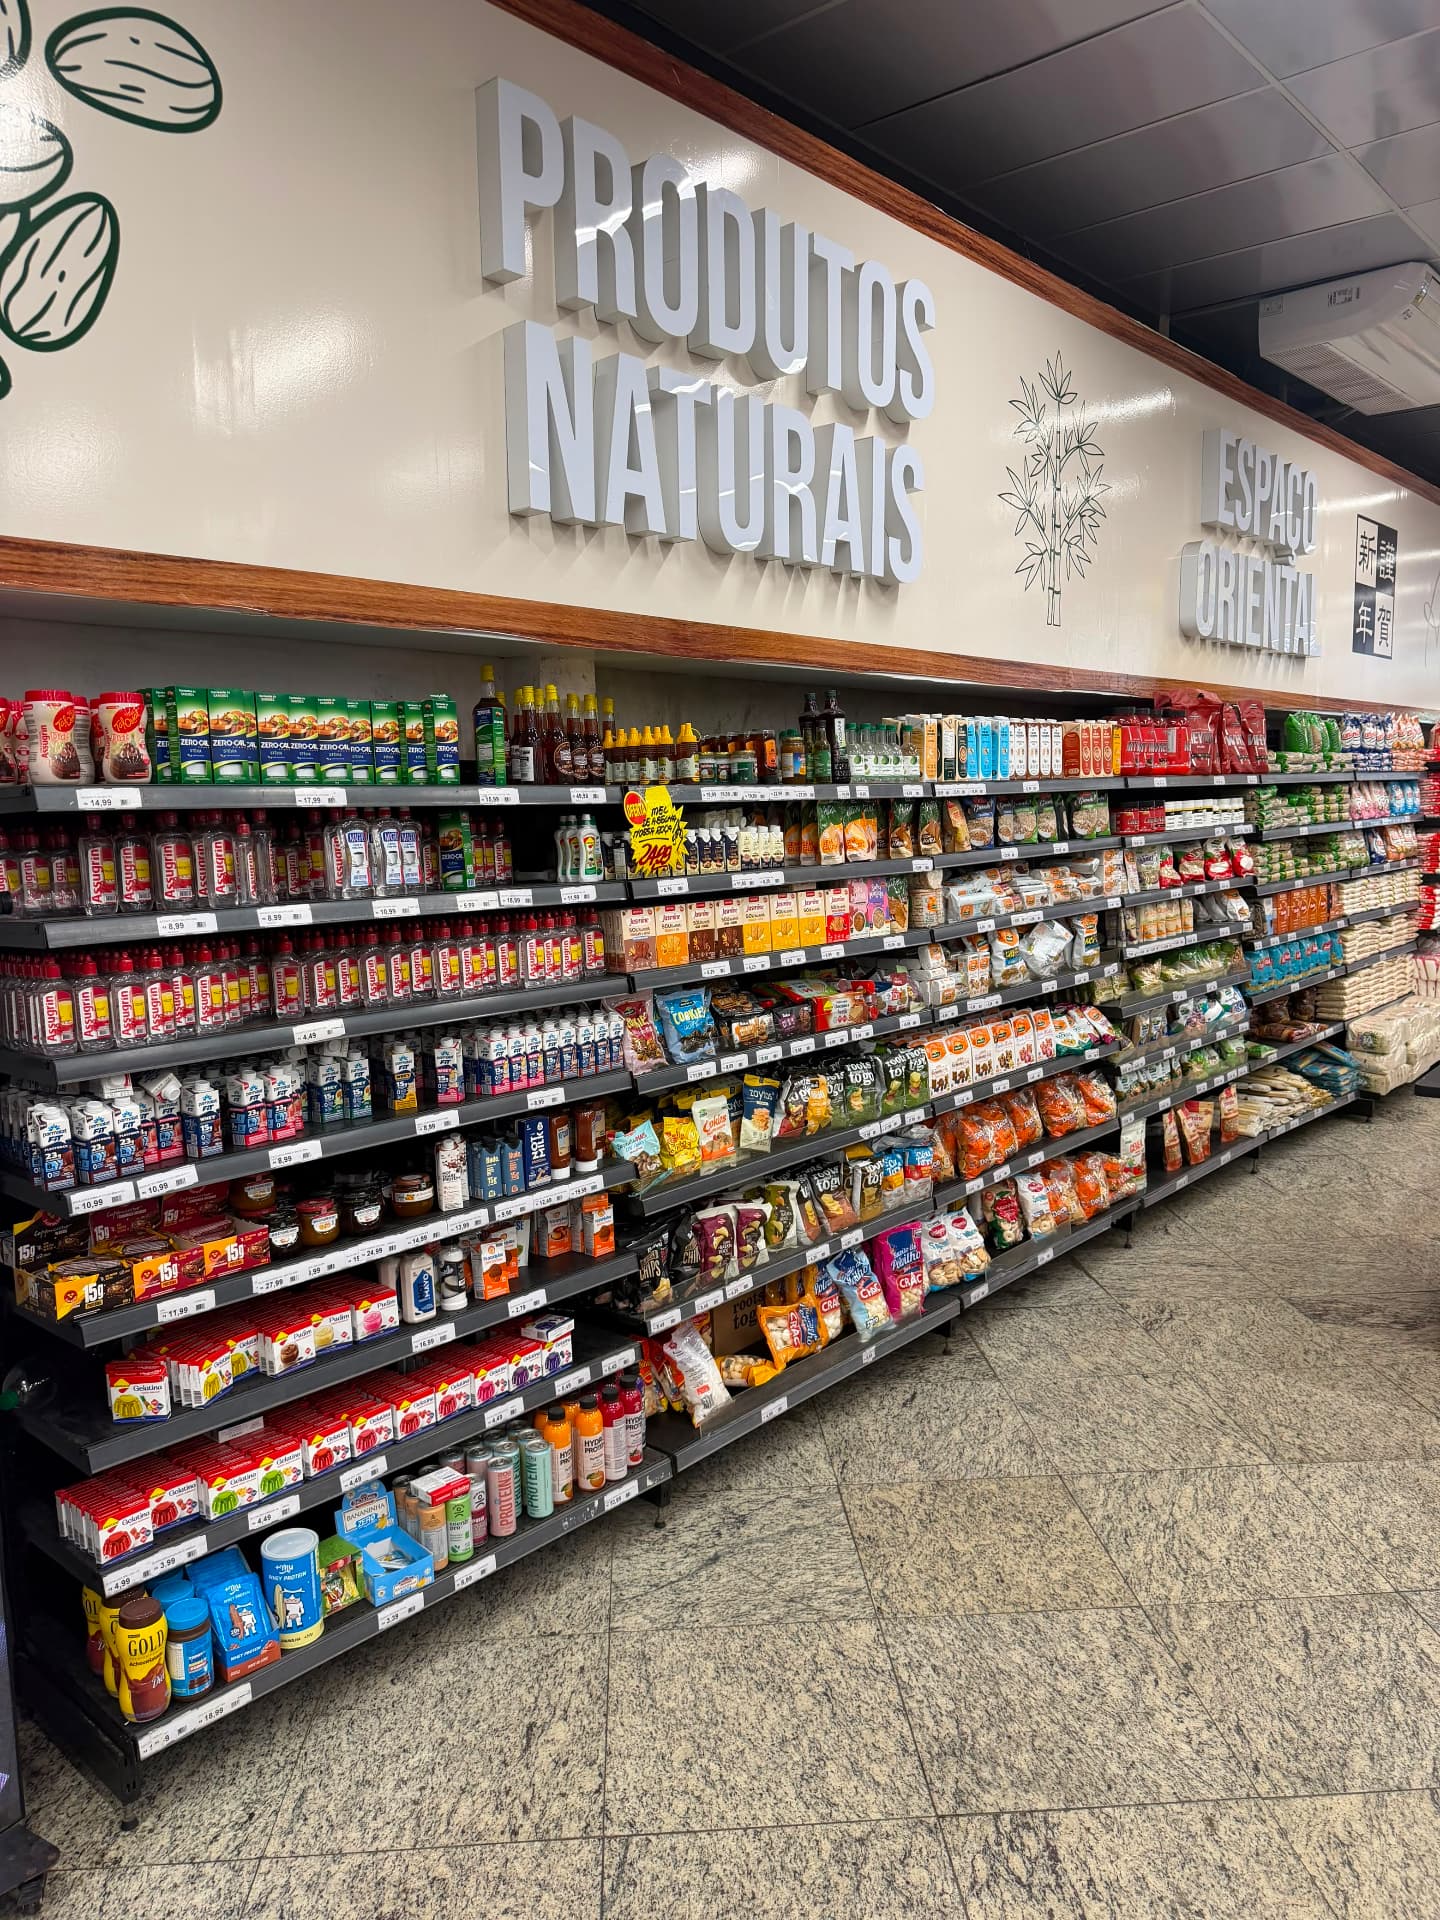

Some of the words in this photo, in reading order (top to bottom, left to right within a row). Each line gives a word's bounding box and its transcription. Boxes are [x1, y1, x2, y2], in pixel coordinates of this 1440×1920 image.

[480, 77, 936, 421] PRODUTOS
[507, 319, 925, 583] NATURAIS
[1206, 429, 1318, 566] ESPAÇO
[1188, 541, 1320, 657] ORIENTAL
[40, 725, 49, 759] Assugrin
[212, 739, 247, 747] ZERO-CAL
[90, 799, 112, 808] 14,99
[91, 847, 102, 903] Assugrin
[123, 847, 135, 901] Assugrin
[164, 845, 174, 898] Assugrin
[215, 841, 224, 894] Assugrin
[168, 921, 185, 931] 8,99
[528, 940, 537, 979] Assugrin
[563, 938, 572, 977] Assugrin
[393, 954, 402, 997] Assugrin
[413, 950, 423, 990] Assugrin
[441, 949, 451, 990] Assugrin
[463, 948, 472, 988] Assugrin
[316, 964, 326, 1005] Assugrin
[340, 960, 350, 1001] Assugrin
[367, 958, 378, 999] Assugrin
[200, 977, 209, 1024] Assugrin
[277, 970, 285, 1011] Assugrin
[46, 995, 58, 1043] Assugrin
[82, 991, 93, 1038] Assugrin
[119, 989, 130, 1036] Assugrin
[151, 986, 161, 1033] Assugrin
[303, 1032, 317, 1041] 4,49
[846, 1061, 872, 1072] roots
[202, 1104, 214, 1112] FIT
[93, 1126, 107, 1135] FIT
[122, 1121, 136, 1129] FIT
[48, 1135, 63, 1143] FIT
[148, 1182, 168, 1194] 10,99
[82, 1198, 103, 1209] 10,99
[164, 1210, 179, 1225] 15g
[94, 1225, 110, 1243] 15g
[18, 1245, 36, 1263] 15g
[224, 1243, 245, 1263] 15g
[158, 1261, 179, 1283] 15g
[640, 1259, 662, 1281] CHIPS
[423, 1273, 431, 1298] MAYO
[900, 1274, 922, 1289] CRAC
[82, 1283, 104, 1304] 15g
[167, 1306, 189, 1317] 11,99
[377, 1298, 397, 1310] Pudim
[328, 1313, 351, 1324] Pudim
[133, 1383, 163, 1393] Gelatina
[369, 1411, 392, 1426] Gelatina
[325, 1429, 349, 1444] Gelatina
[275, 1451, 302, 1466] Gelatina
[229, 1471, 257, 1486] Gelatina
[349, 1475, 363, 1487] 4,49
[526, 1463, 538, 1509] PROTEIN
[169, 1482, 198, 1498] Gelatina
[347, 1501, 386, 1522] BANANINHA
[498, 1479, 514, 1527] PROTEIN
[121, 1510, 151, 1526] Gelatina
[257, 1513, 273, 1525] 4,49
[356, 1513, 378, 1527] ZERO
[160, 1557, 177, 1570] 3,99
[114, 1577, 131, 1590] 4,99
[283, 1571, 307, 1581] PROTEIN
[128, 1629, 165, 1657] GOLD
[204, 1706, 225, 1723] 18,99
